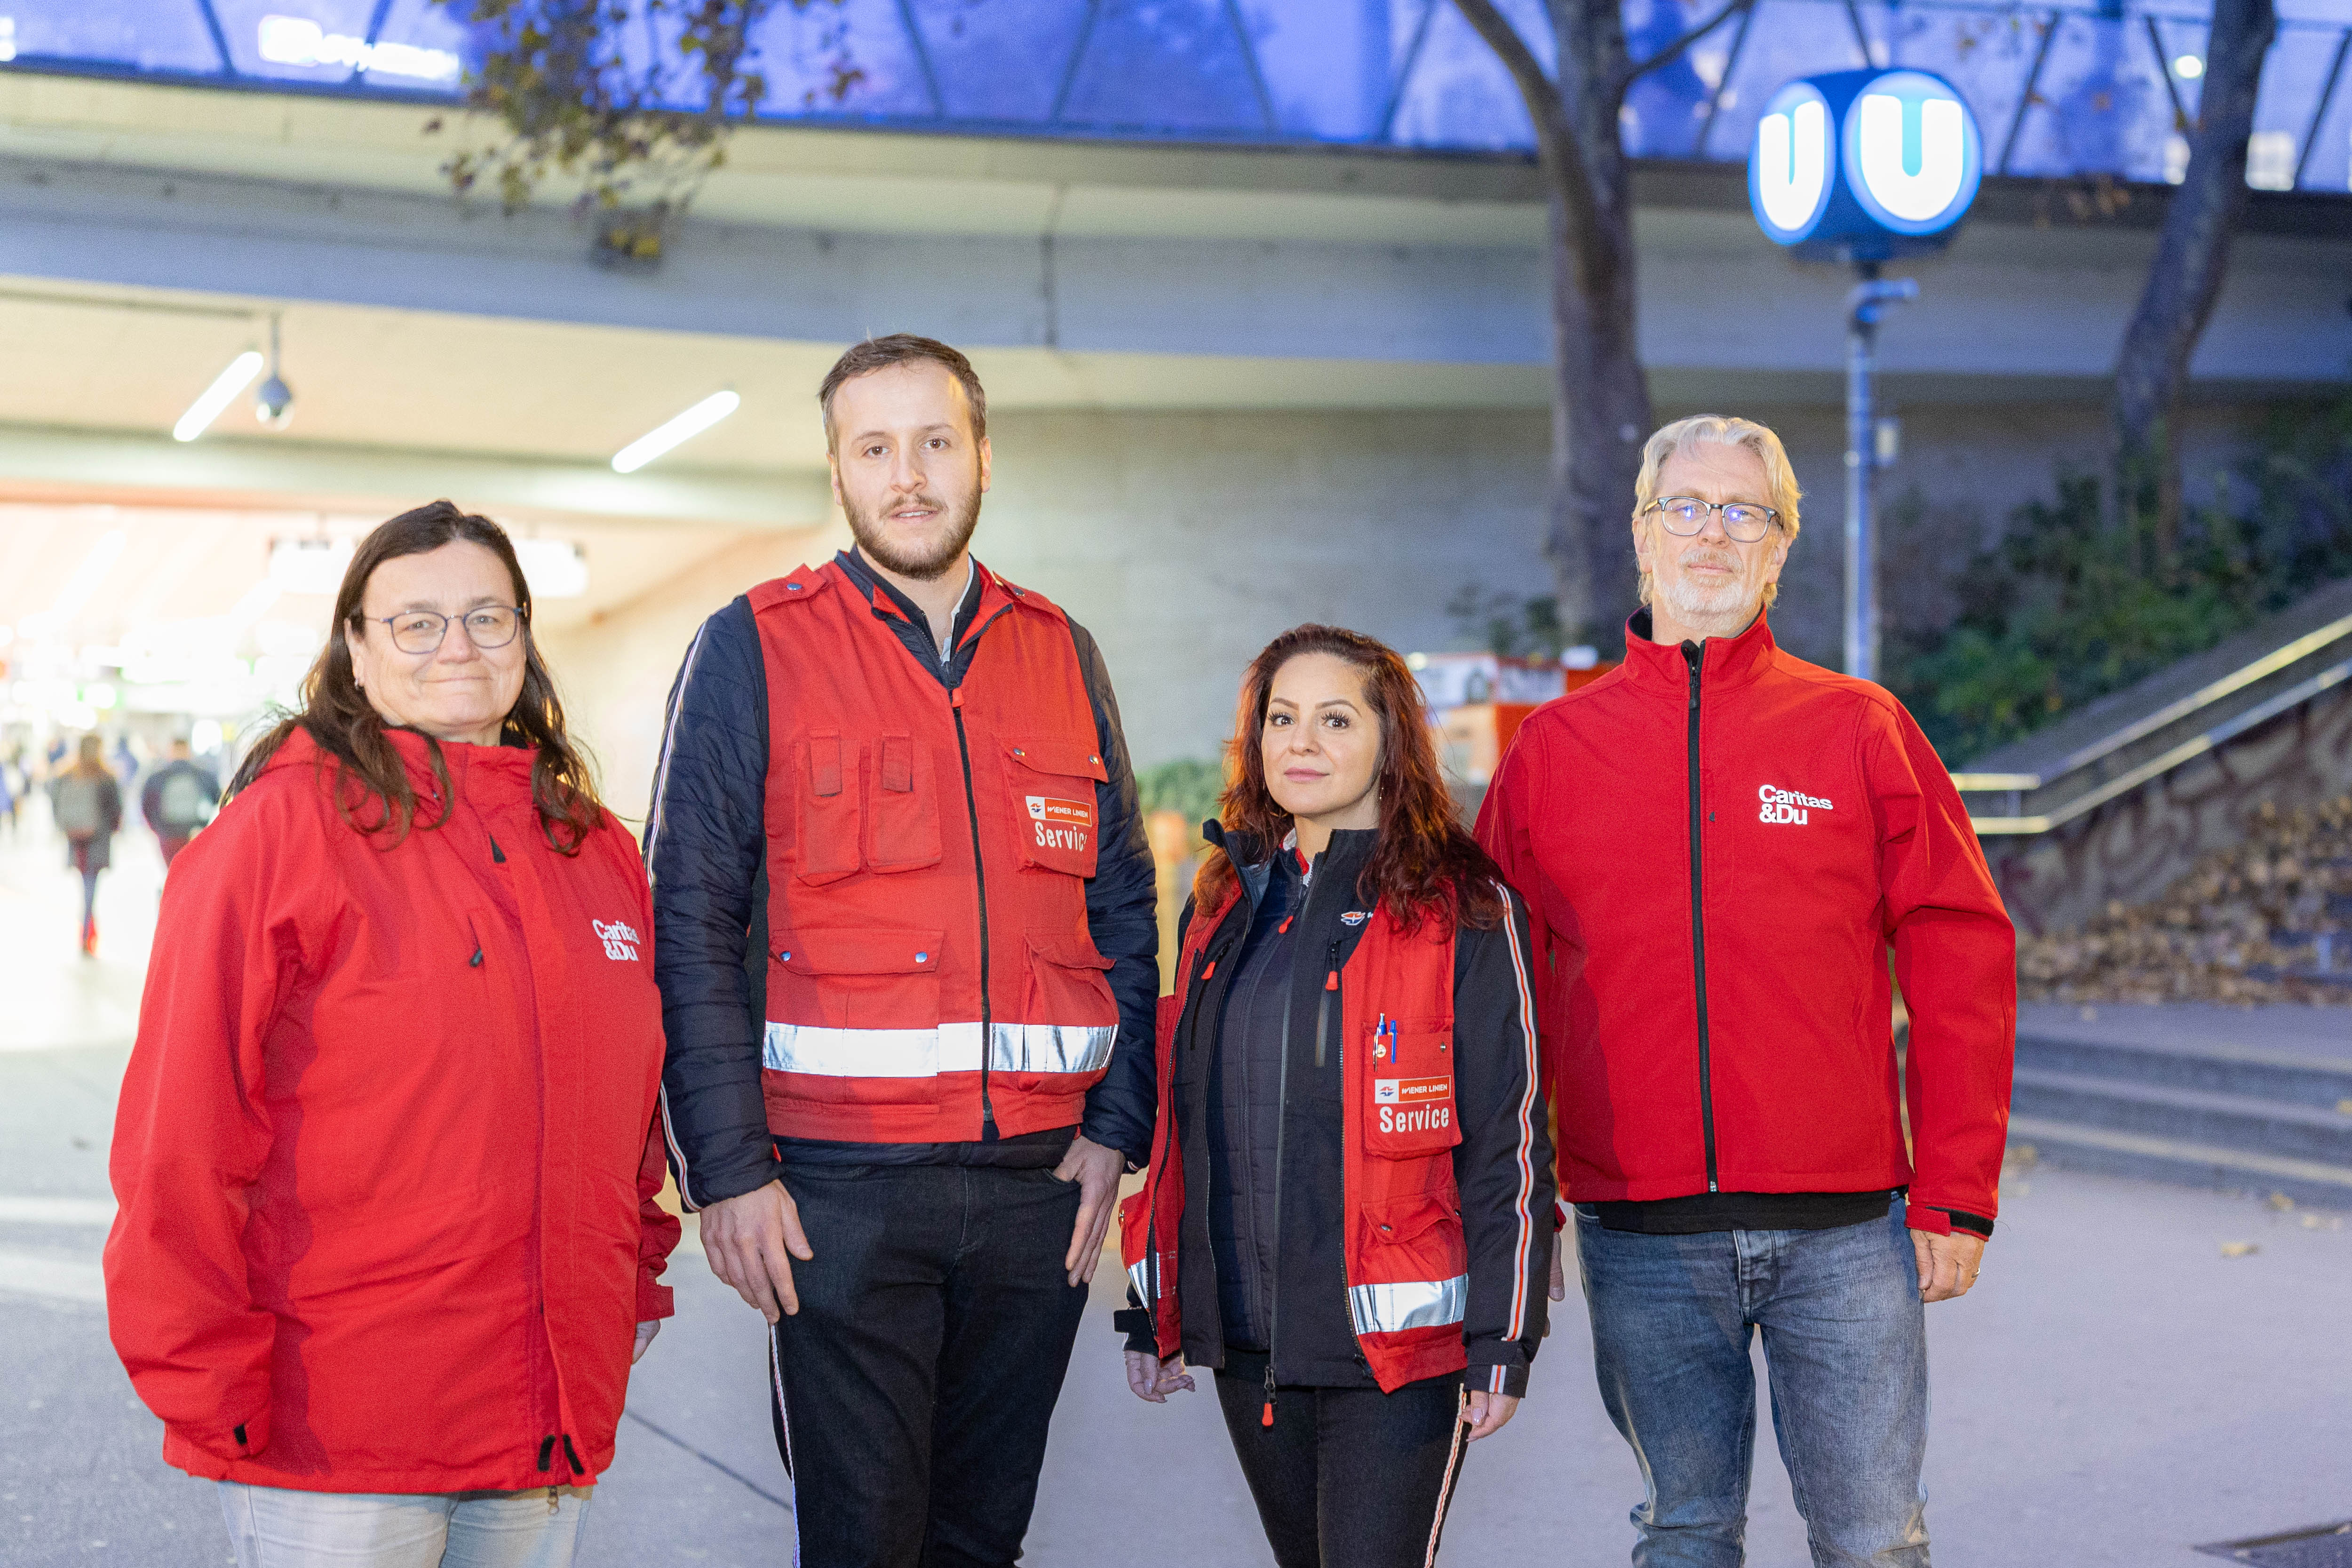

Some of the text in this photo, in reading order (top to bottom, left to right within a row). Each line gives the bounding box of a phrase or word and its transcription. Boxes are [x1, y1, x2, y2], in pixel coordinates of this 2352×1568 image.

[1759, 100, 1824, 231] U
[1860, 95, 1963, 221] U
[1759, 784, 1834, 810] Caritas
[1047, 806, 1088, 818] WIENER LINIEN
[1759, 803, 1808, 825] &Du
[603, 940, 639, 961] &Du
[1401, 1083, 1447, 1094] WIENER LINIEN
[1380, 1104, 1449, 1133] Service
